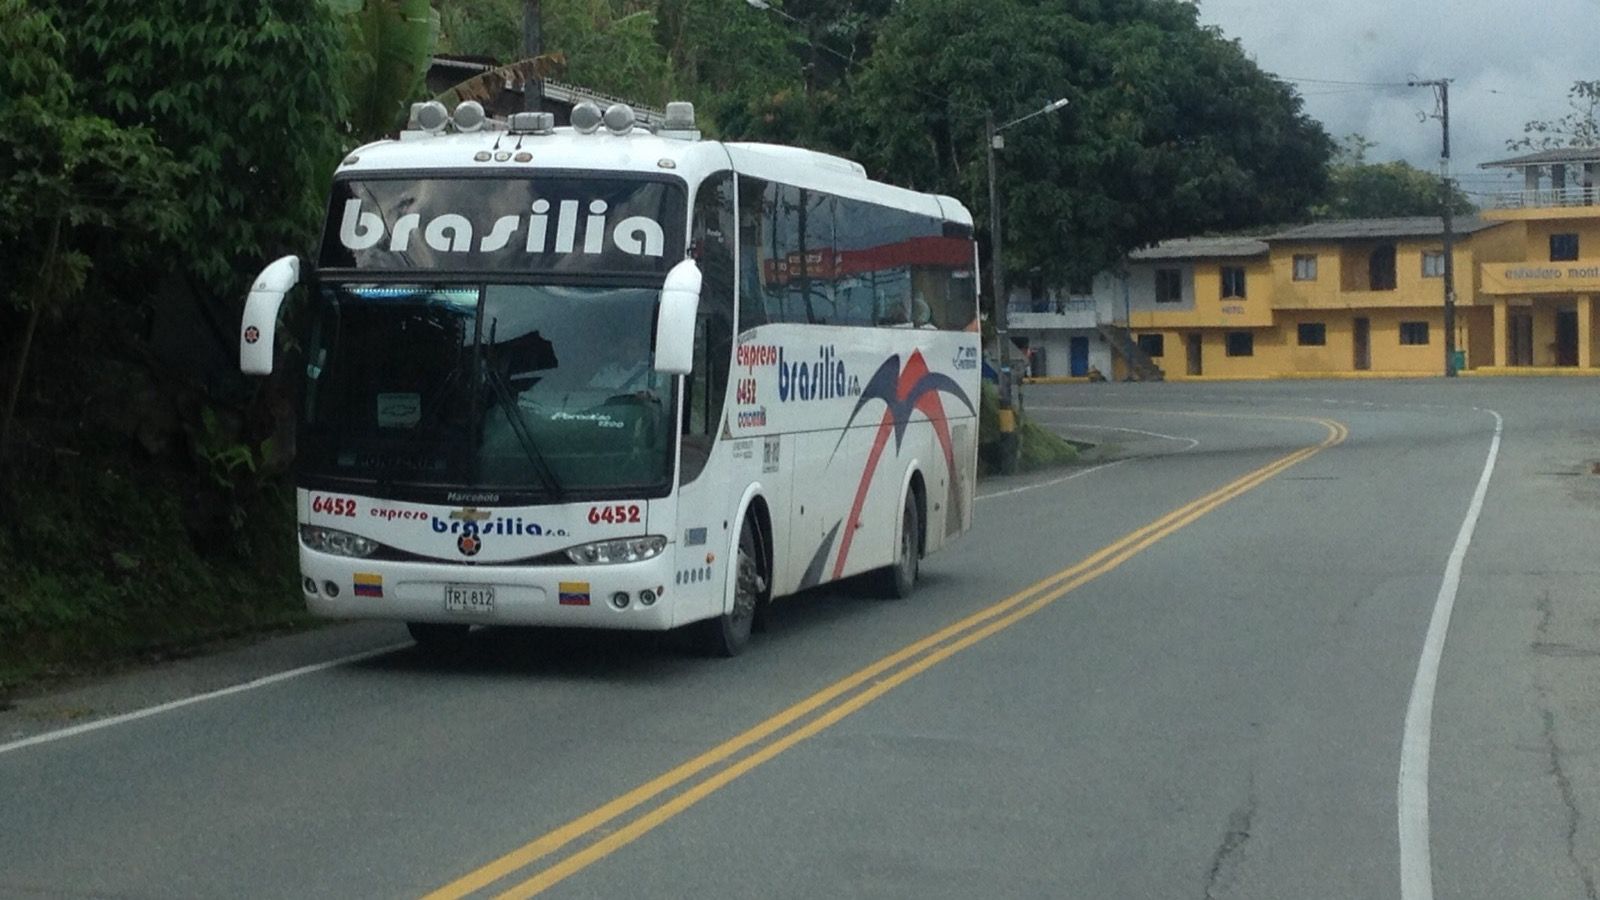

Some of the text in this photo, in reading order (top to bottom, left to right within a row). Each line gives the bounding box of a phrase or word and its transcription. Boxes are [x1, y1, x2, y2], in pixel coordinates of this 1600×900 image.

[339, 198, 664, 257] brasilia
[736, 345, 777, 375] expreso
[778, 344, 846, 402] brasilia
[736, 378, 757, 405] 6452
[312, 495, 357, 518] 6452
[588, 504, 641, 525] 6452
[370, 507, 428, 521] expreso
[432, 516, 542, 536] brasilia
